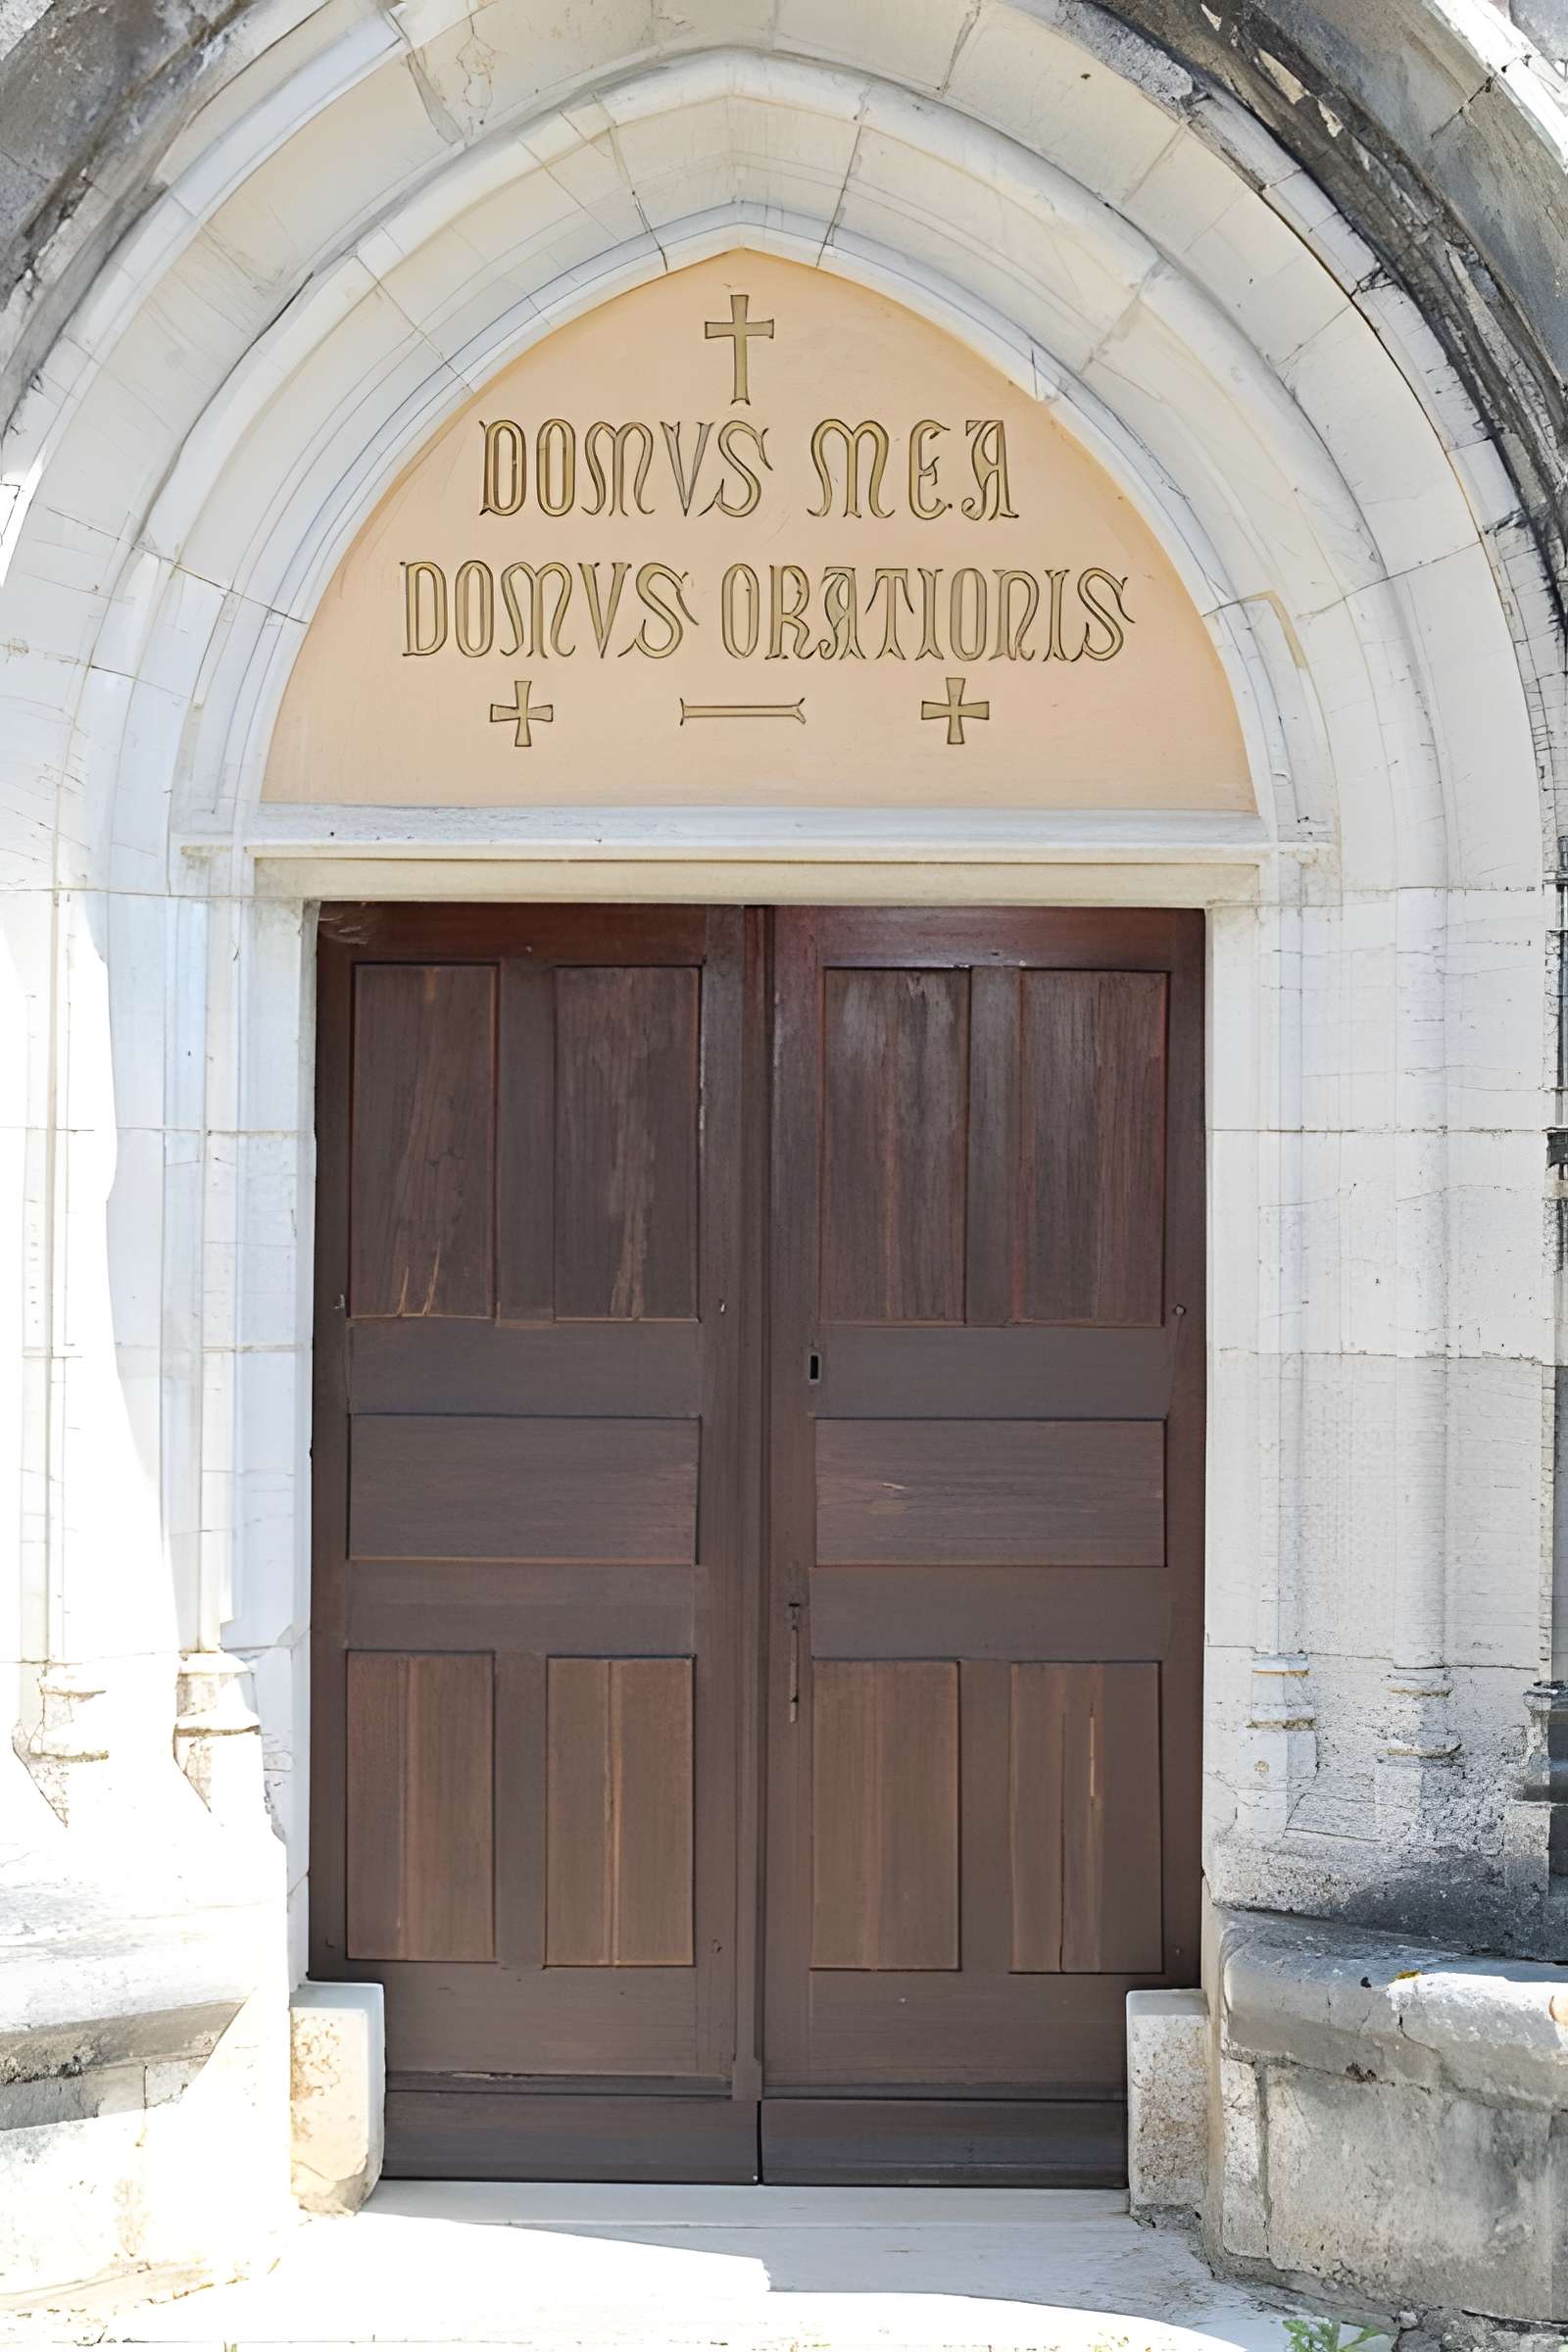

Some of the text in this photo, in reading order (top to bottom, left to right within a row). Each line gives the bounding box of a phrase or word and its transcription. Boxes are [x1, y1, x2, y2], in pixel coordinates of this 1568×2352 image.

[478, 418, 1019, 520] DOMVS MEA
[399, 560, 1136, 662] DOMVS ORATIONIS
